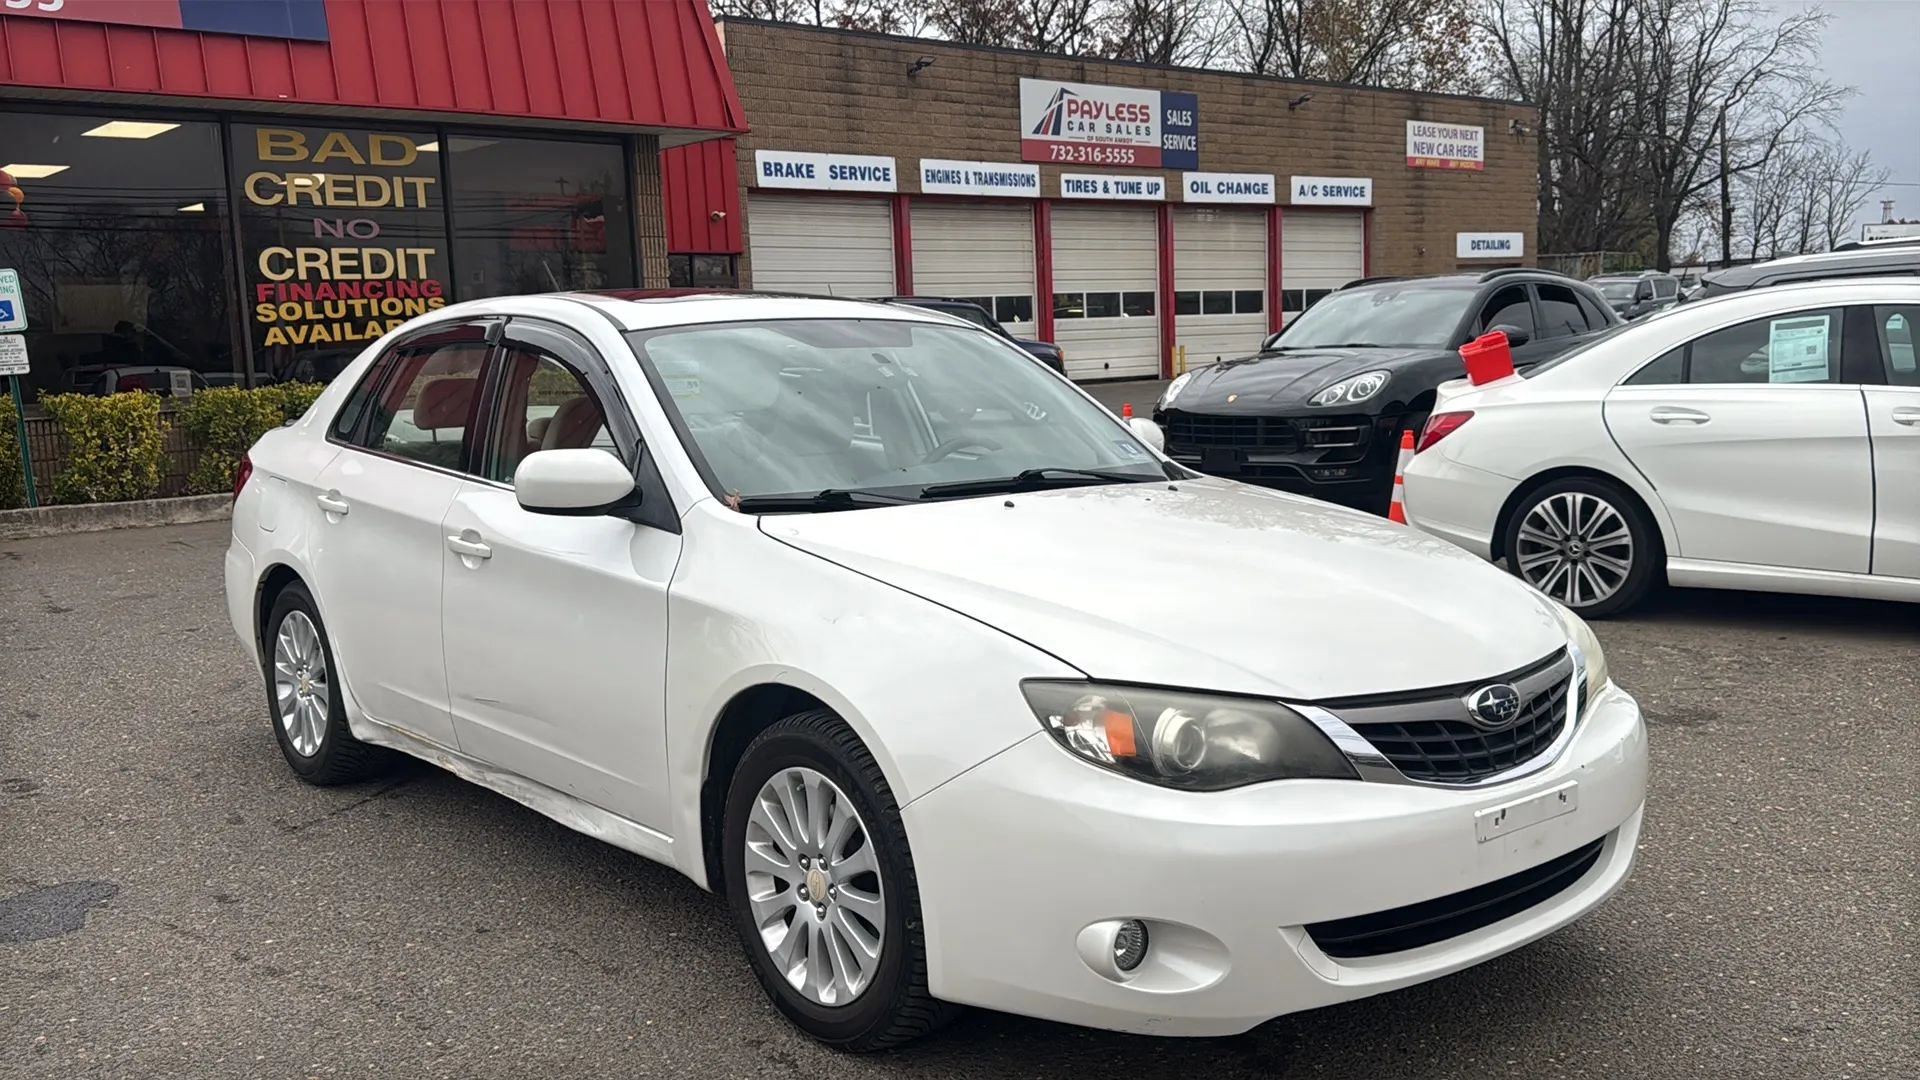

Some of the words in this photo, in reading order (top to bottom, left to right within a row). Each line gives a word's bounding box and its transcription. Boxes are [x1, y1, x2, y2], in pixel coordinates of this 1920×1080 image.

[1067, 99, 1151, 123] PAYLESS
[1166, 109, 1192, 127] SALES
[1067, 120, 1096, 133] CAR
[1105, 123, 1151, 136] SALES
[1413, 125, 1436, 138] LEASE
[1438, 128, 1458, 139] YOUR
[1460, 130, 1479, 141] NEXT
[256, 128, 418, 166] BAD
[1163, 134, 1197, 151] SERVICE
[1413, 141, 1435, 155] NEW
[1436, 144, 1455, 157] CAR
[1456, 146, 1479, 158] HERE
[1050, 145, 1135, 164] 732-316-5555
[763, 161, 815, 179] BRAKE
[829, 164, 892, 182] SERVICE
[925, 169, 962, 185] ENGINES
[964, 172, 971, 185] &
[973, 172, 1037, 188] TRANSMISSIONS
[244, 172, 436, 208] CREDIT
[1065, 180, 1098, 193] TIRES
[1103, 181, 1110, 194] &
[1114, 181, 1143, 194] TUNE
[1146, 182, 1161, 195] UP
[1190, 181, 1212, 194] OIL
[1217, 182, 1269, 195] CHANGE
[1299, 185, 1318, 197] A/C
[1322, 185, 1366, 198] SERVICE
[313, 218, 380, 239] NO
[1471, 240, 1511, 250] DETAILING
[258, 247, 436, 281] CREDIT
[256, 279, 442, 303] FINANCING
[256, 297, 446, 323] SOLUTIONS
